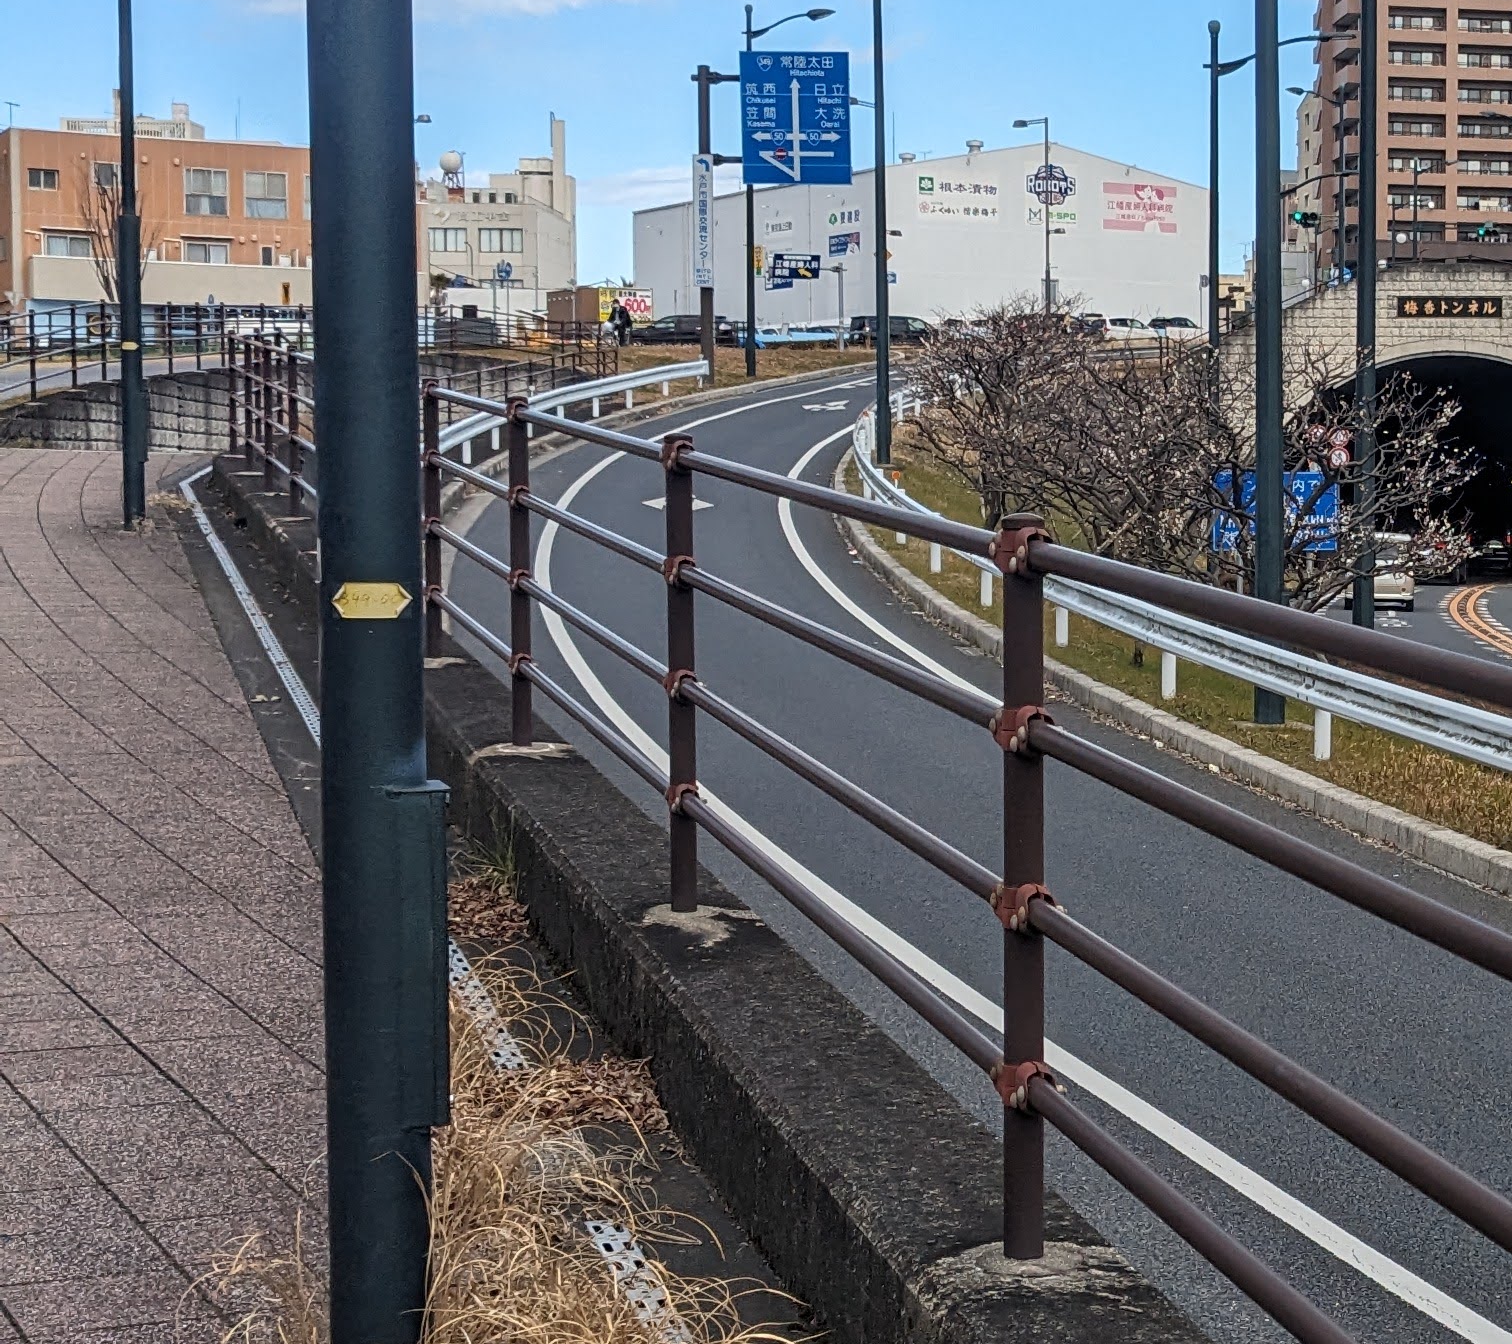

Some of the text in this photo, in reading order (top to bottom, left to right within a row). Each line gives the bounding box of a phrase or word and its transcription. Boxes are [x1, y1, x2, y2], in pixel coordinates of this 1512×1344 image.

[780, 56, 833, 68] 常陸太田
[746, 83, 776, 95] 筑西
[815, 83, 845, 96] 日立
[746, 107, 776, 119] 笠間
[815, 107, 846, 119] 大洗
[774, 132, 783, 140] 50
[939, 182, 997, 195] 根本漬物
[699, 174, 708, 268] 水戸市国際交流センター
[1404, 299, 1496, 315] 梅香トンネル
